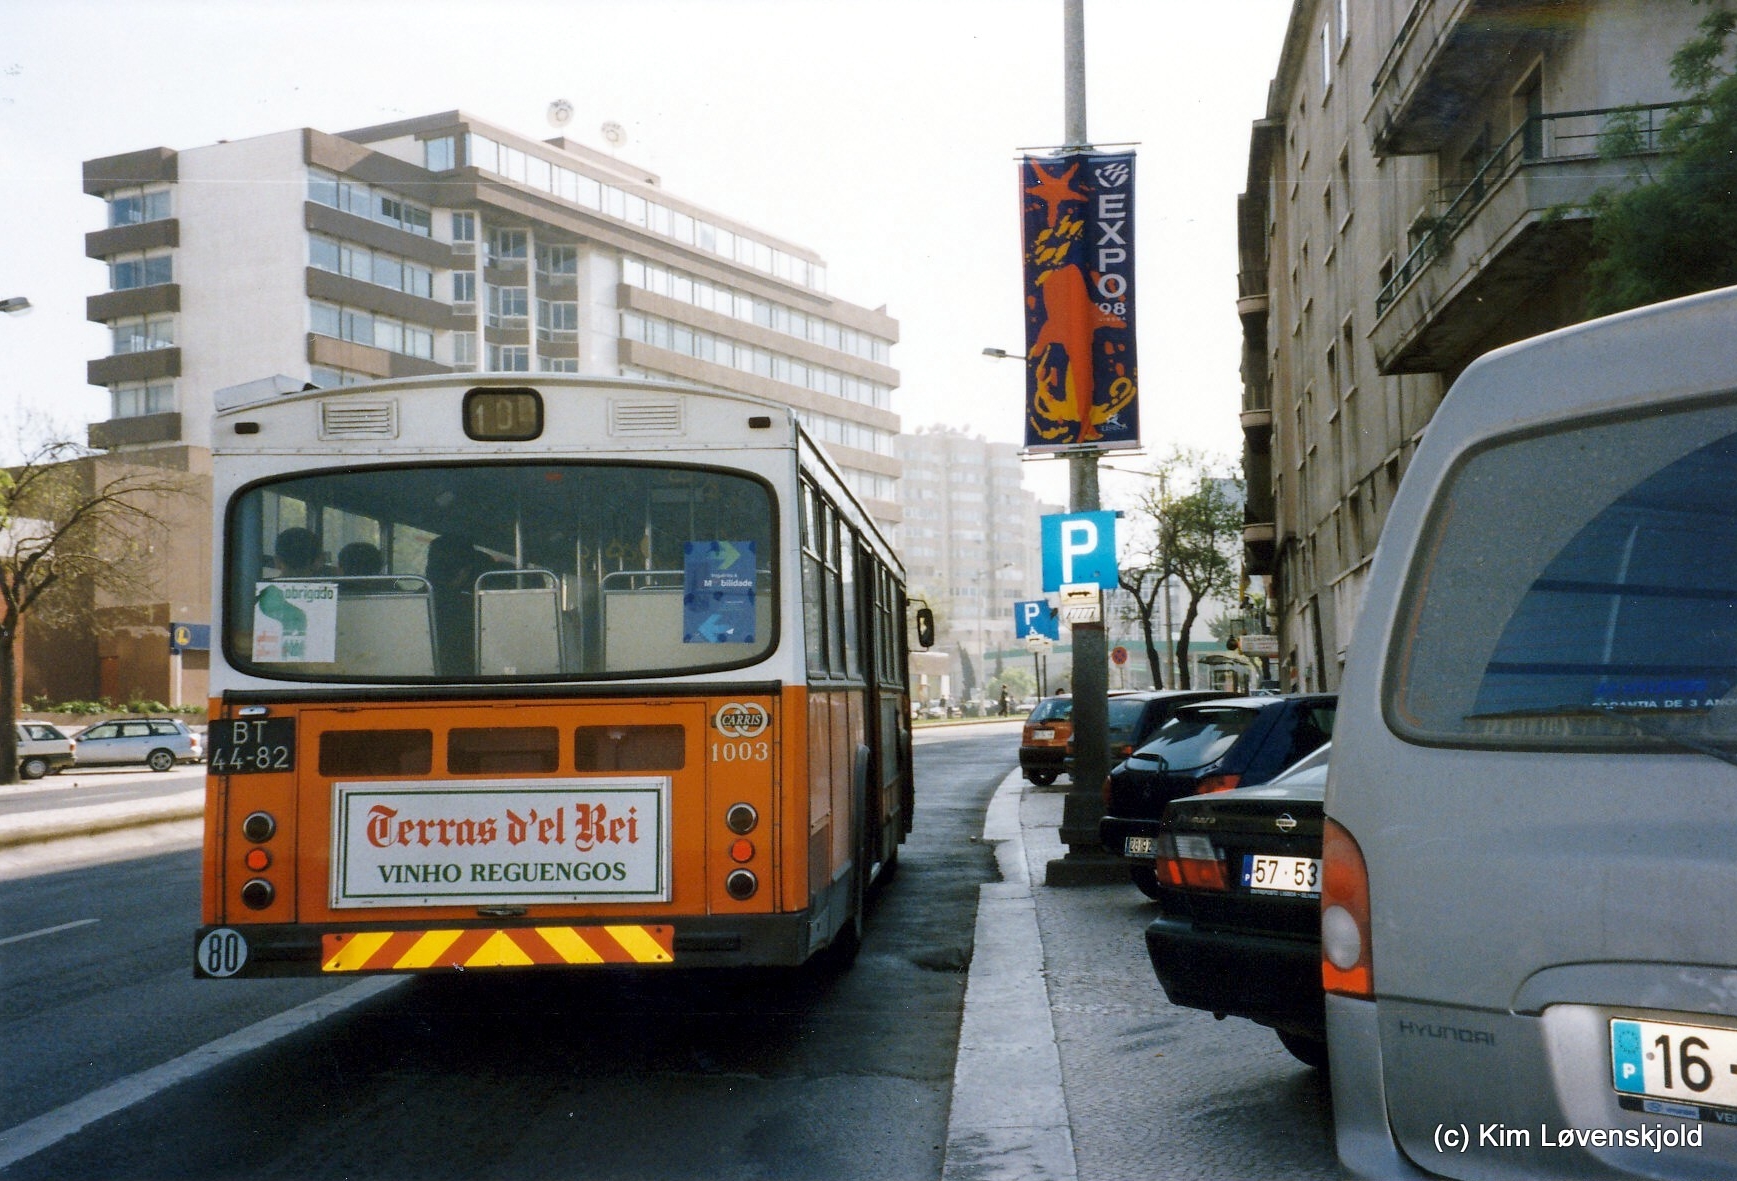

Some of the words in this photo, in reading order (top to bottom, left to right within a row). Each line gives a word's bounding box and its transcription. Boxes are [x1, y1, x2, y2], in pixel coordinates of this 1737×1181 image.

[1098, 194, 1127, 299] EXPO
[1061, 520, 1098, 583] P
[285, 586, 333, 602] obrigado
[1024, 603, 1040, 625] P
[1664, 699, 1683, 708] DE
[1690, 699, 1698, 707] 3
[722, 714, 761, 726] CARRIS
[232, 721, 267, 745] BT
[211, 746, 290, 770] 44-82
[712, 742, 769, 762] 1003
[366, 804, 497, 848] Terras
[507, 807, 565, 846] d'el
[575, 803, 639, 852] Rei
[378, 863, 463, 884] VINHO
[470, 862, 628, 883] REGUENGOS
[1244, 873, 1251, 882] P
[207, 933, 238, 973] 80
[1399, 1020, 1495, 1046] HYUNDAI
[1622, 1062, 1636, 1079] P
